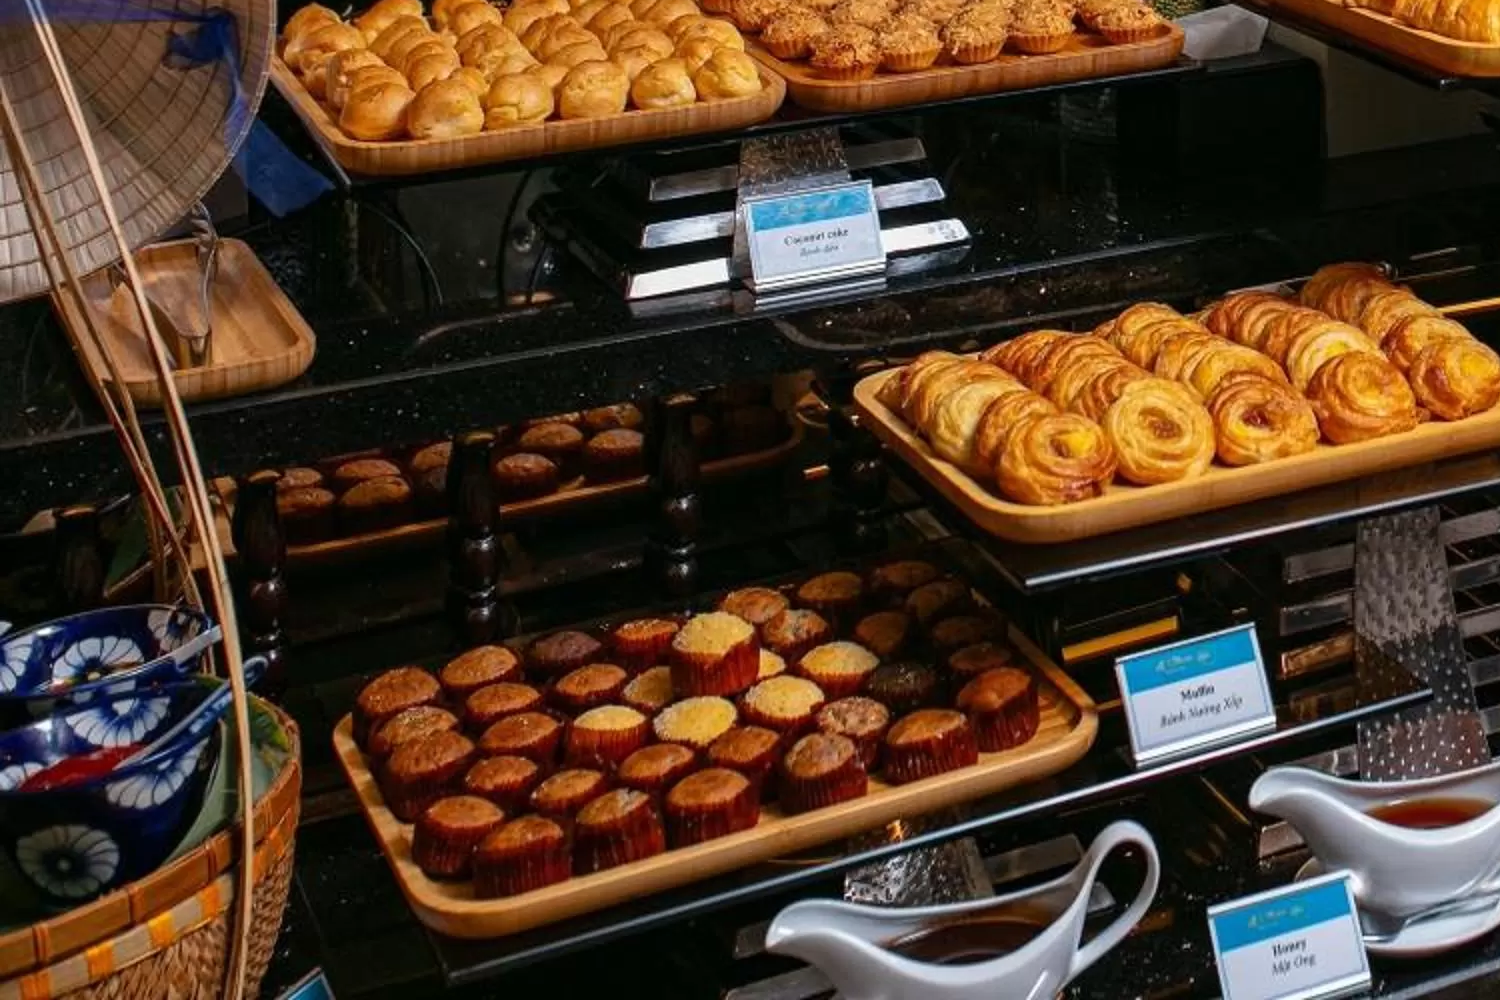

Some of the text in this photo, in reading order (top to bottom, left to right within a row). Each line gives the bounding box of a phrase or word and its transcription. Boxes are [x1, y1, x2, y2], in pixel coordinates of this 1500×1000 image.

[783, 227, 849, 247] Coconut cake
[1179, 683, 1215, 701] Muffin
[1159, 711, 1187, 729] Bánh
[1271, 938, 1307, 957] Honey
[1293, 953, 1316, 968] Ong
